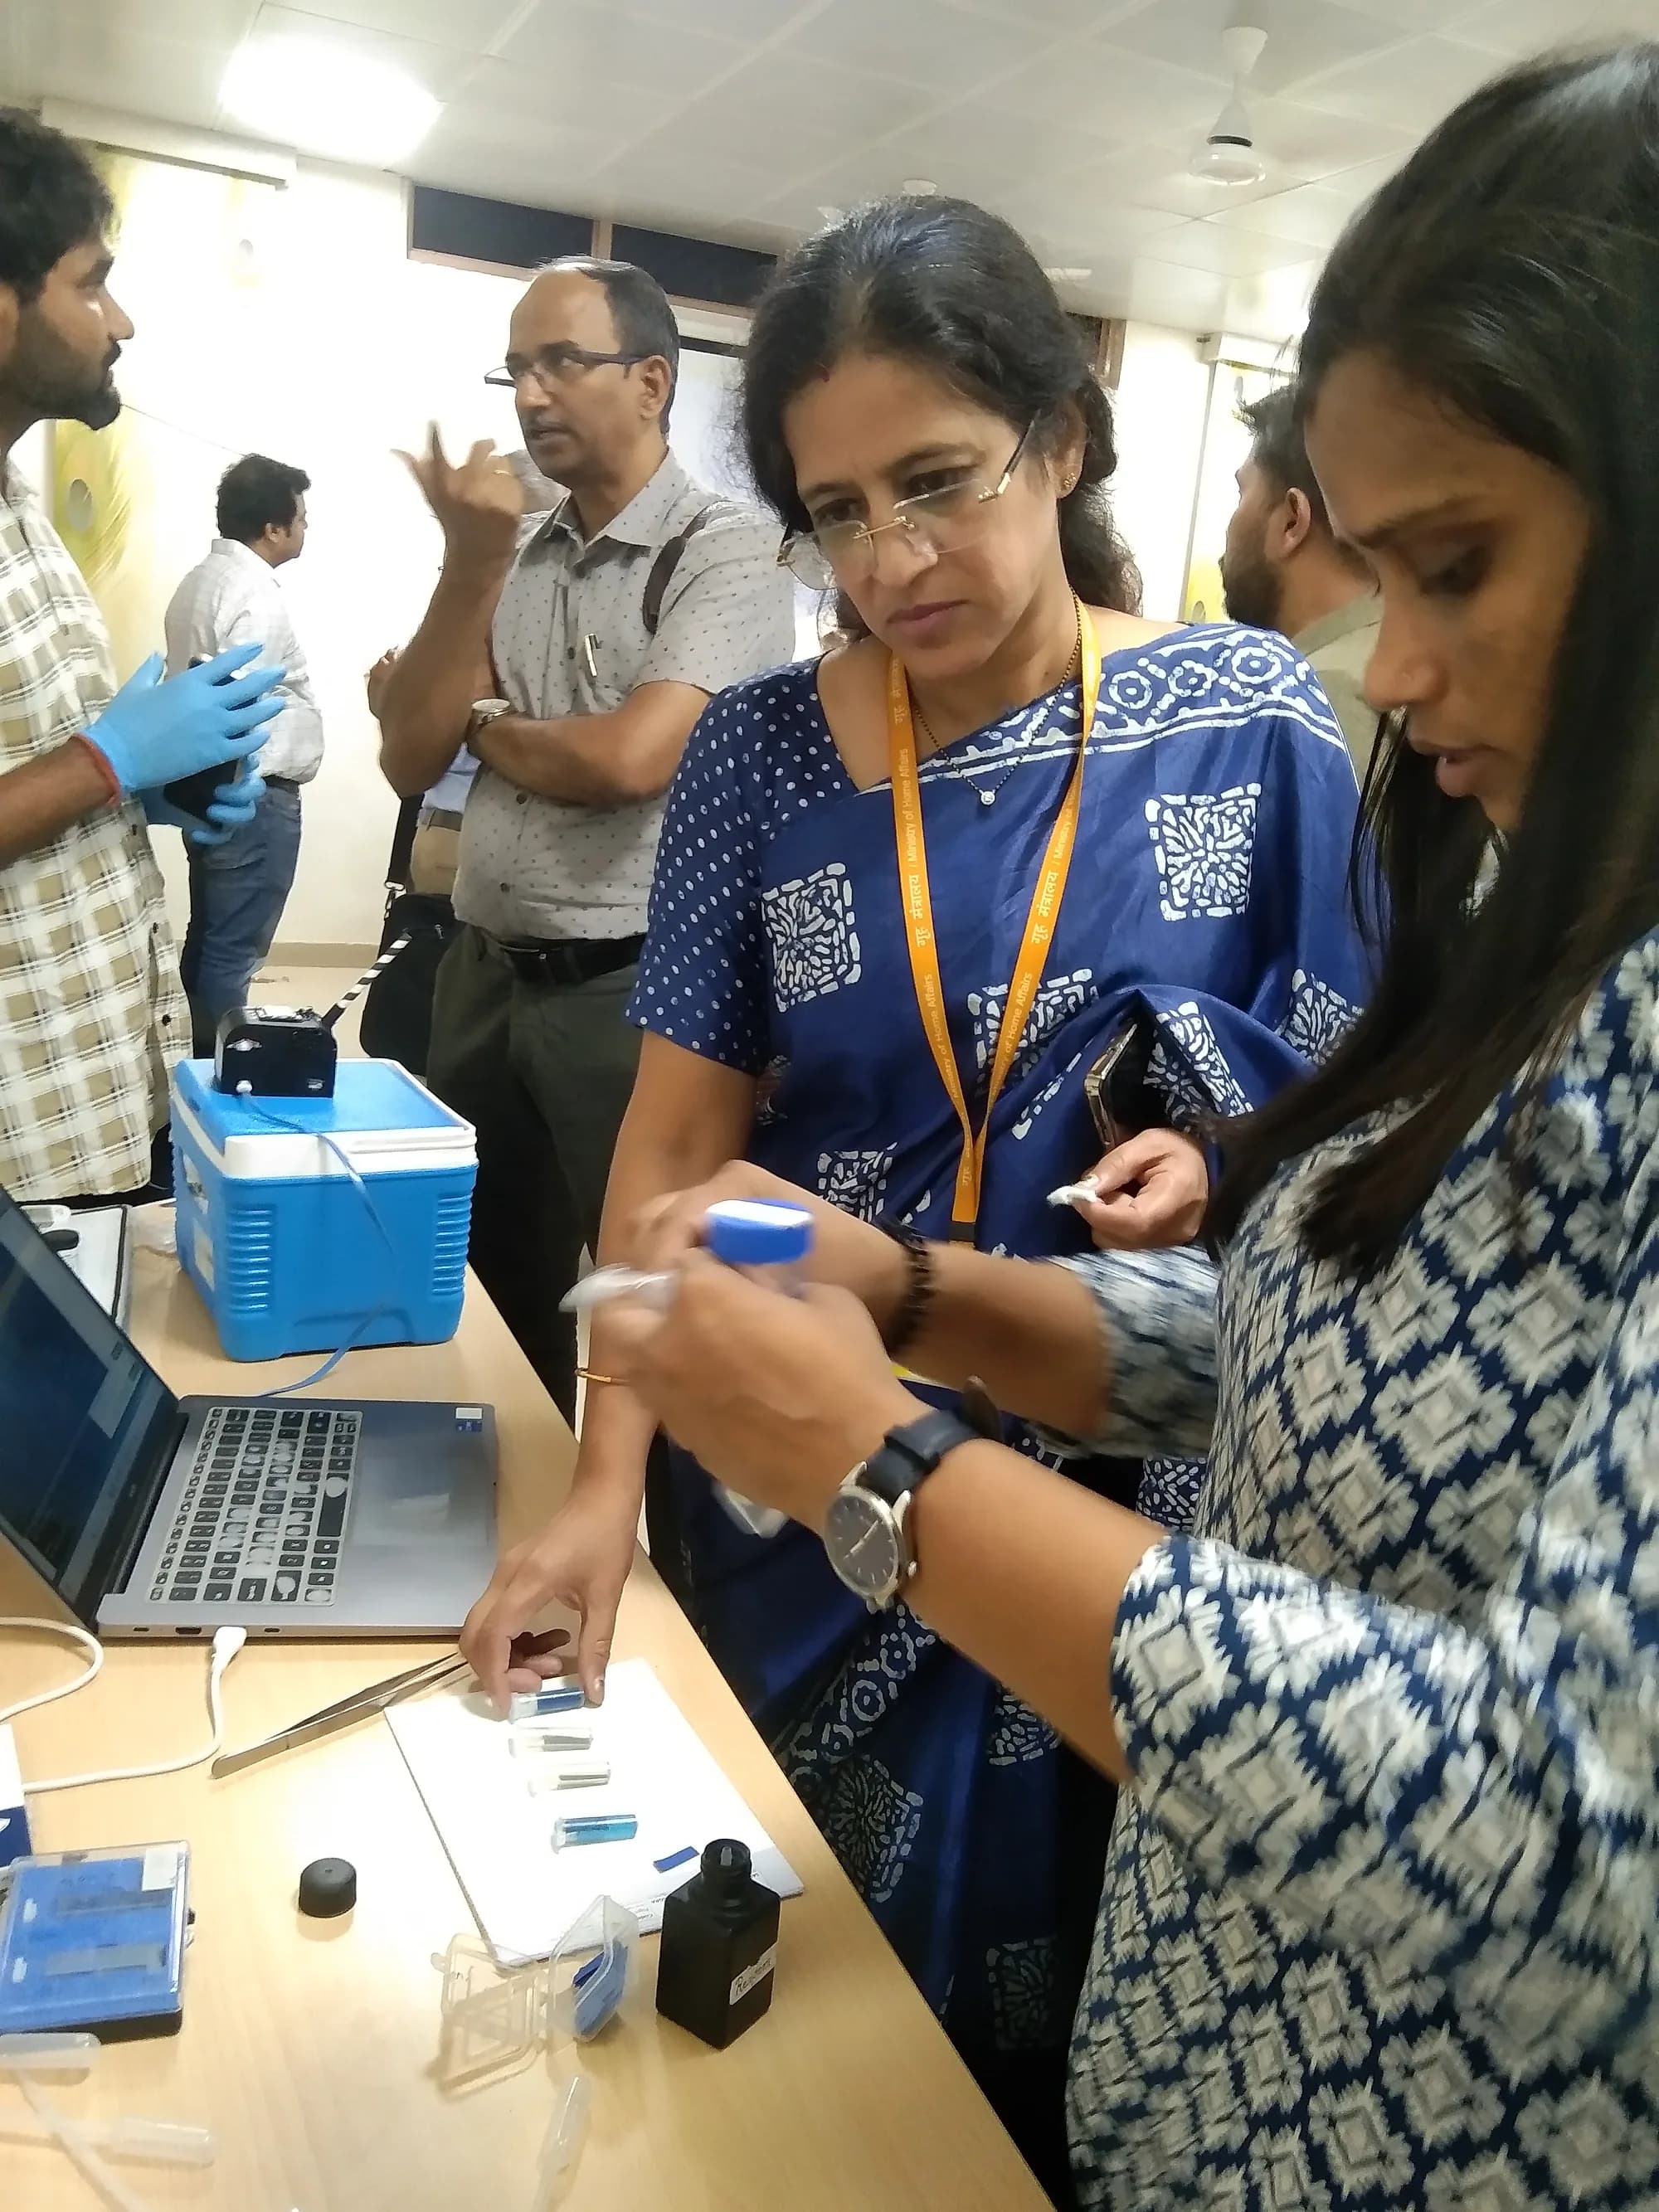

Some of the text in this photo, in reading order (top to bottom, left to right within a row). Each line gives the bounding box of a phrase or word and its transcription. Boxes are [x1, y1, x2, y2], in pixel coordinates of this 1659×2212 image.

[898, 748, 909, 777] Affairs
[902, 780, 911, 809] Home
[902, 809, 914, 820] of
[905, 822, 917, 862] Ministry
[1053, 820, 1072, 859] Ministry
[908, 873, 923, 920] मंत्रालय
[1037, 870, 1059, 917] मंत्रालय
[915, 926, 932, 947] गृह
[1031, 921, 1048, 944] गृह
[924, 973, 937, 1007] Affairs
[931, 1009, 943, 1041] Home
[1005, 971, 1033, 1054] of Home Affairs
[937, 1043, 947, 1055] of
